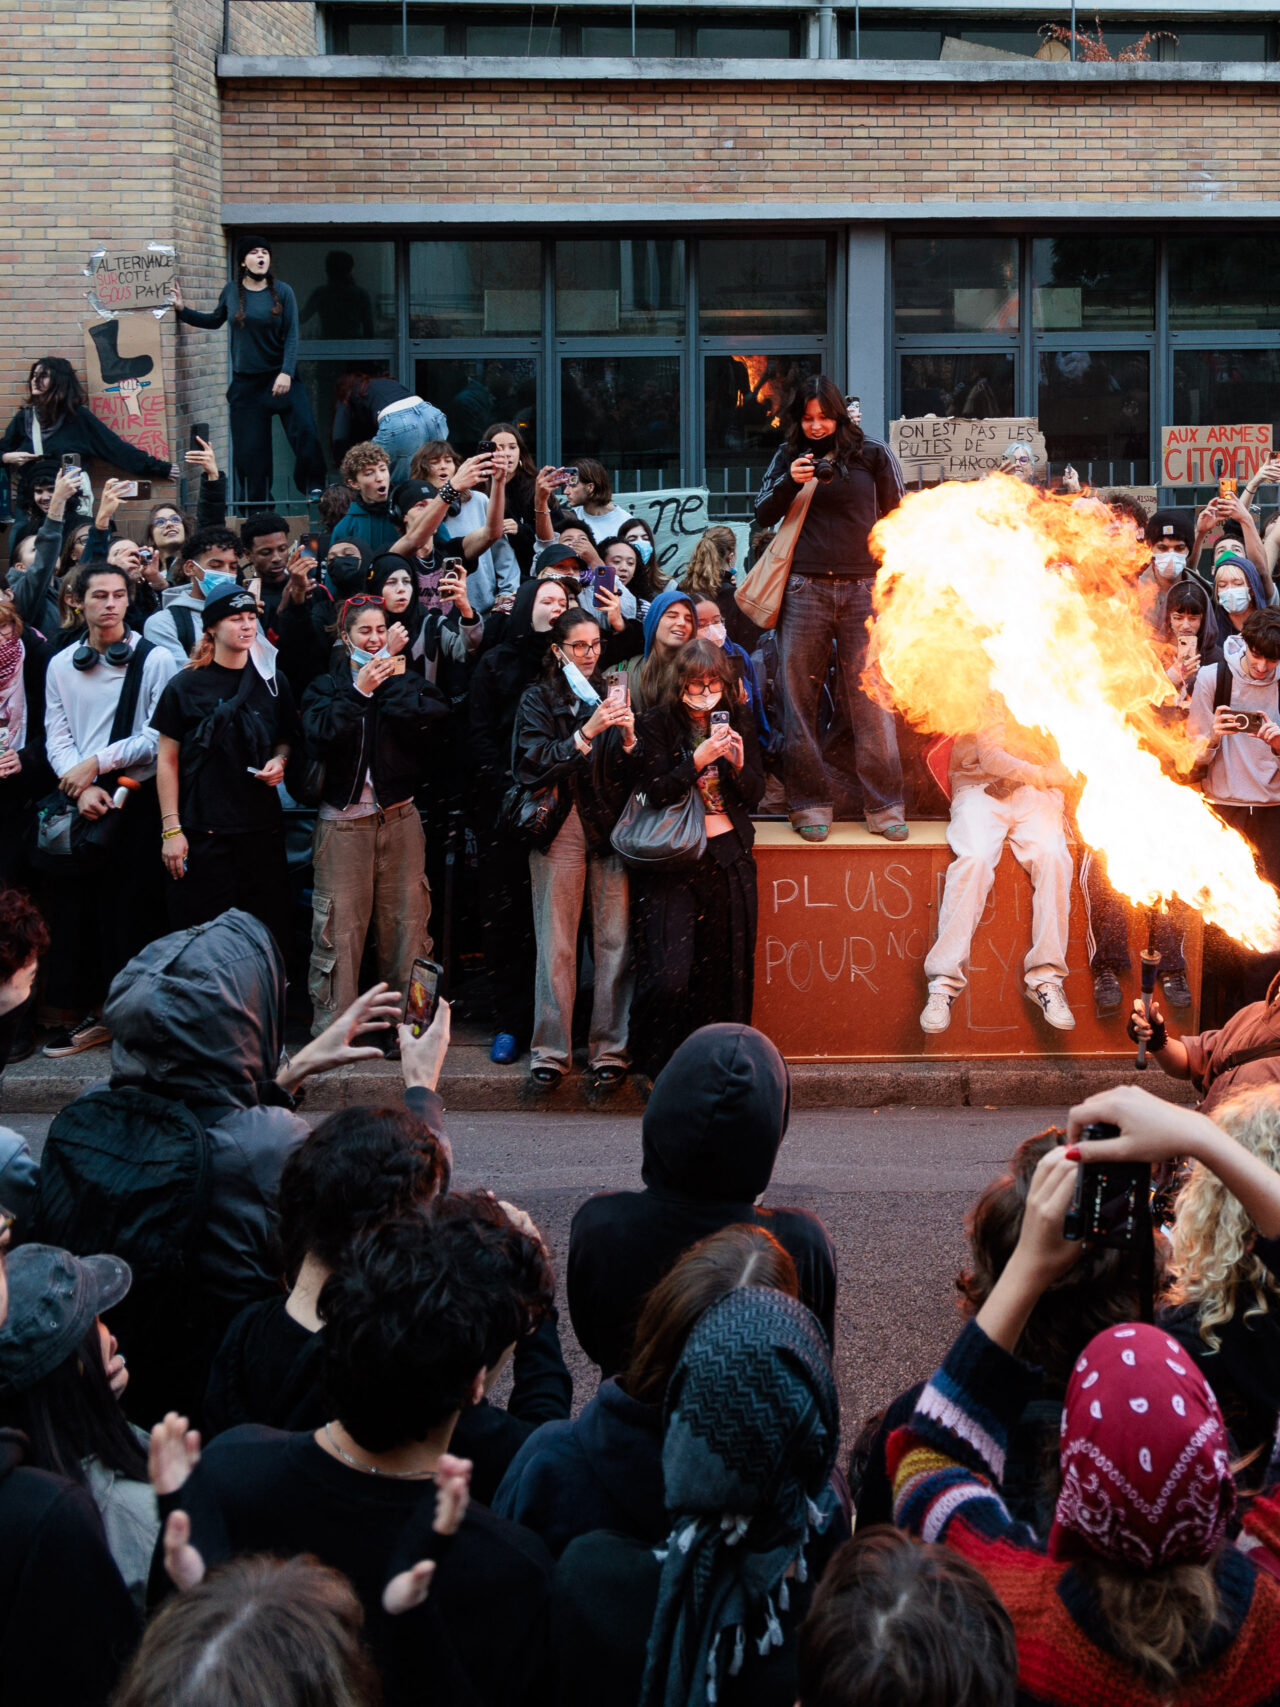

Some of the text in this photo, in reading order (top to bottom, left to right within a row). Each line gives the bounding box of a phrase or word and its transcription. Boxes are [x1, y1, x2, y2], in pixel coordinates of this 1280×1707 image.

[96, 254, 174, 273] ALTERNANCE
[99, 285, 132, 305] SOUS
[91, 394, 166, 416] FAUT CE
[900, 422, 1034, 442] ON EST PAS LES
[1167, 426, 1270, 446] AUX ARMES
[899, 438, 985, 456] PUTES DE
[773, 863, 913, 920] PLUS
[766, 935, 879, 993] POUR
